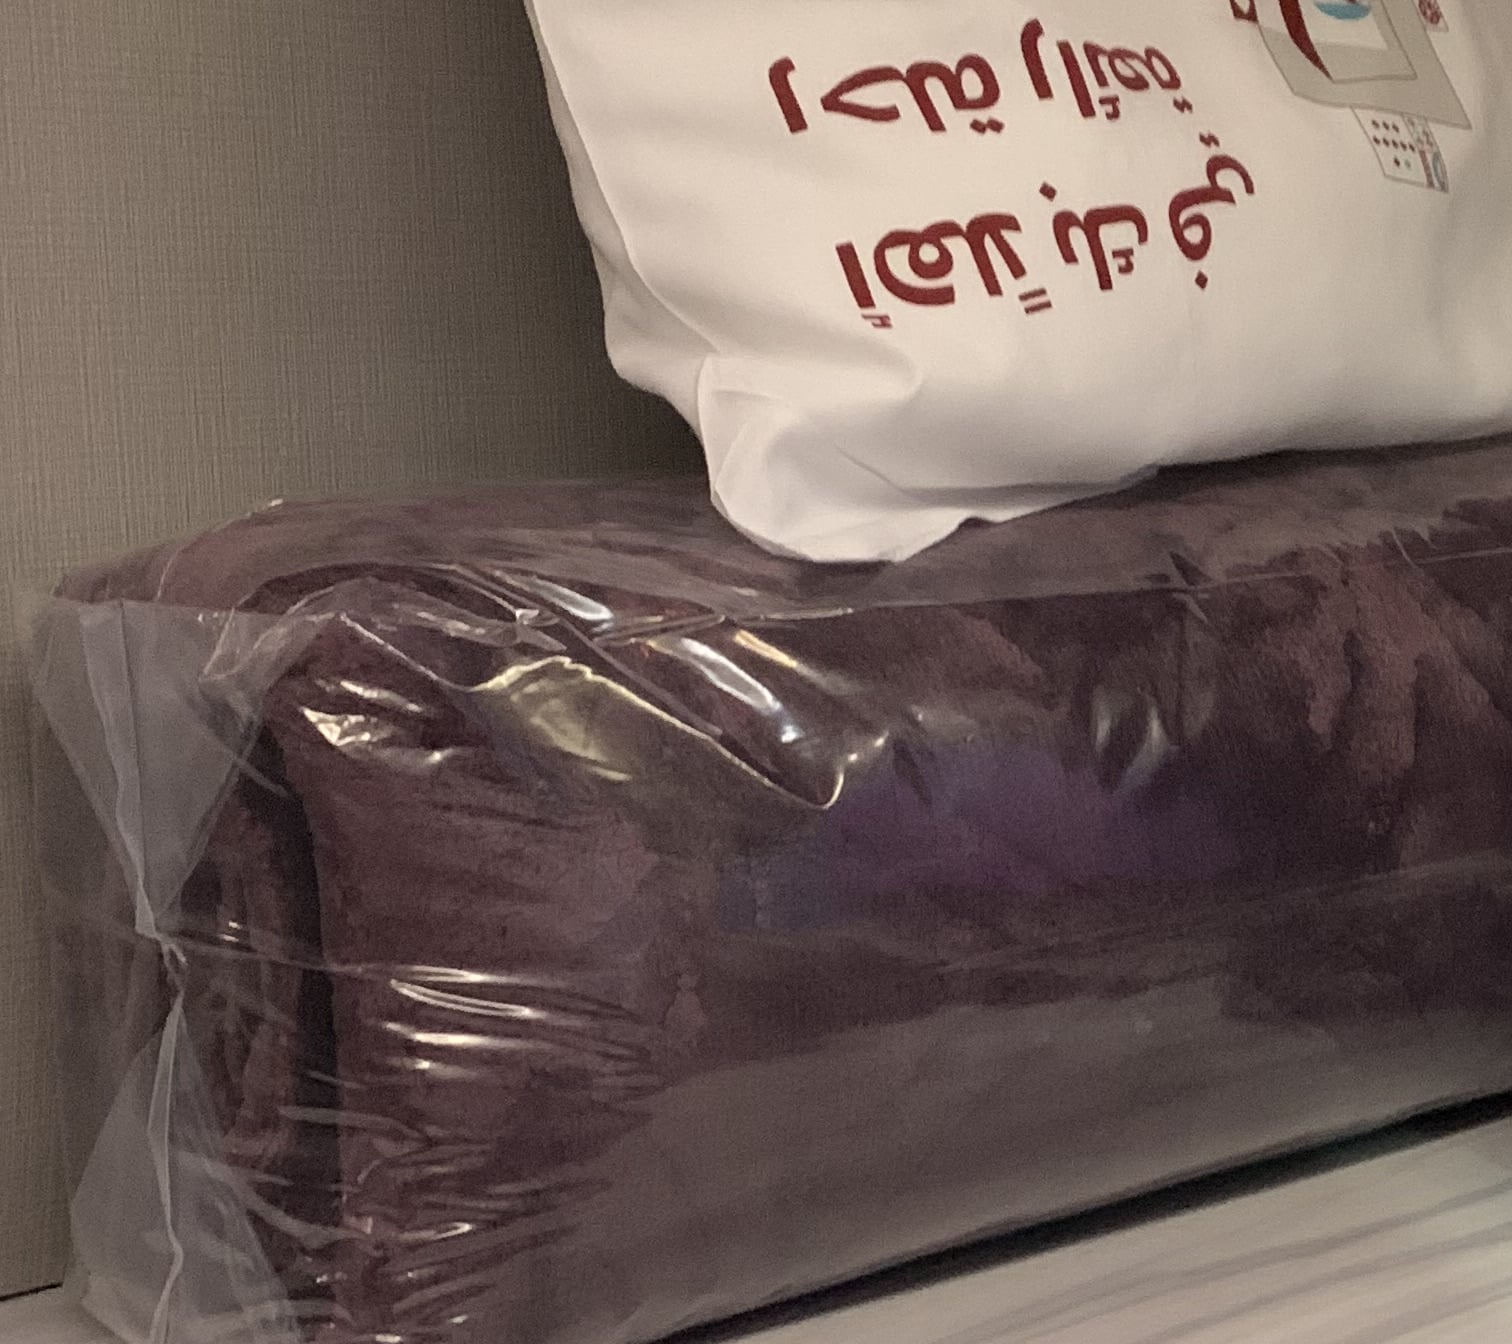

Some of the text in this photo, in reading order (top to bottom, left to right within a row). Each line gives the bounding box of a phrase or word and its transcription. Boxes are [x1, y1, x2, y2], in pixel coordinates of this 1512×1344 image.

[768, 18, 1194, 134] رحلة رائعة
[836, 131, 1256, 329] أهلاً بك في
